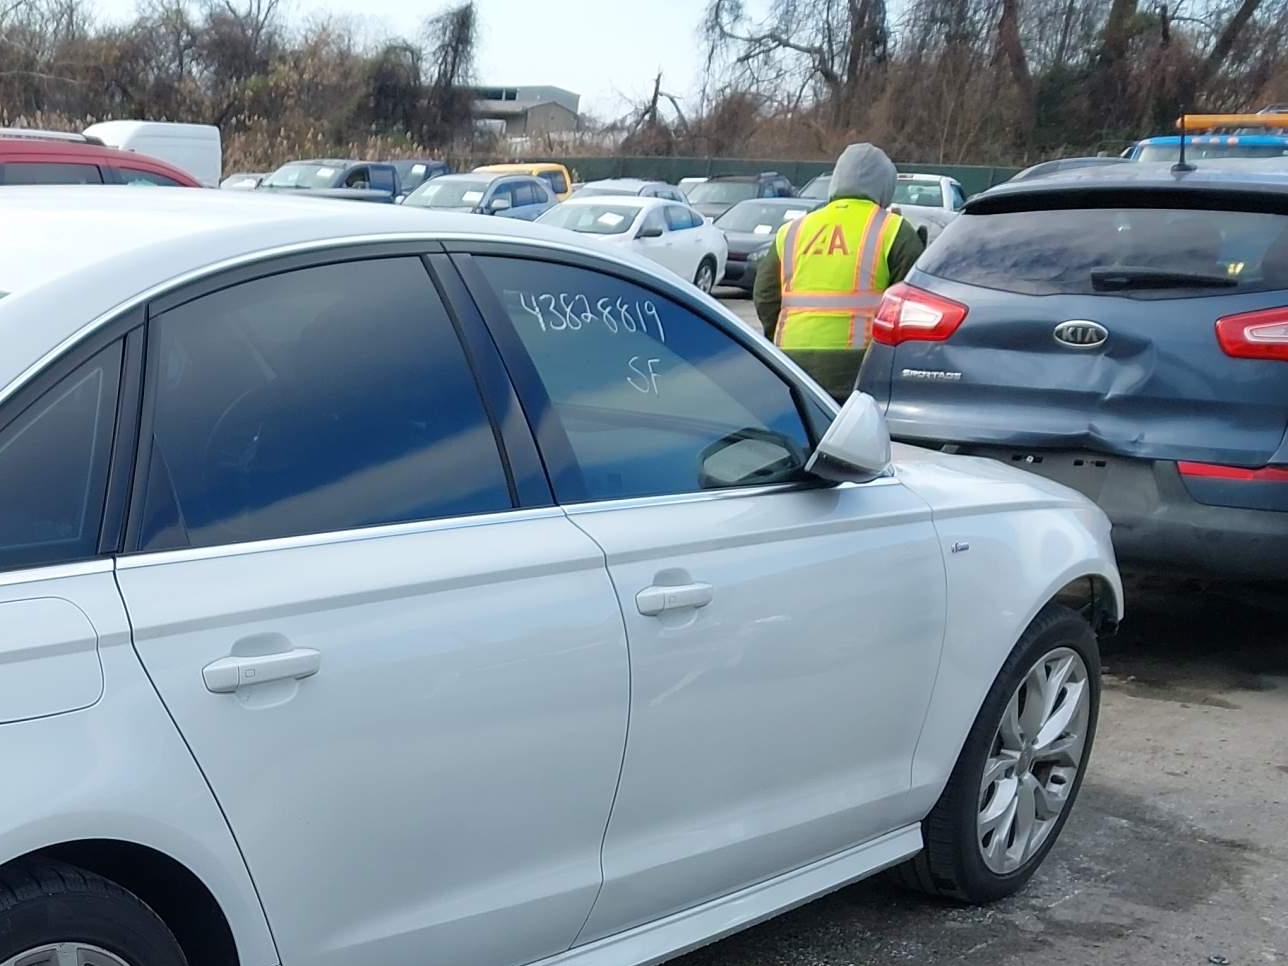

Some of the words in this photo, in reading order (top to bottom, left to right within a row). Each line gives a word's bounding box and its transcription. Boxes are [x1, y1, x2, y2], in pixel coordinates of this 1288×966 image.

[520, 292, 665, 342] 43828819
[1062, 327, 1098, 342] KIA
[626, 356, 661, 394] SF
